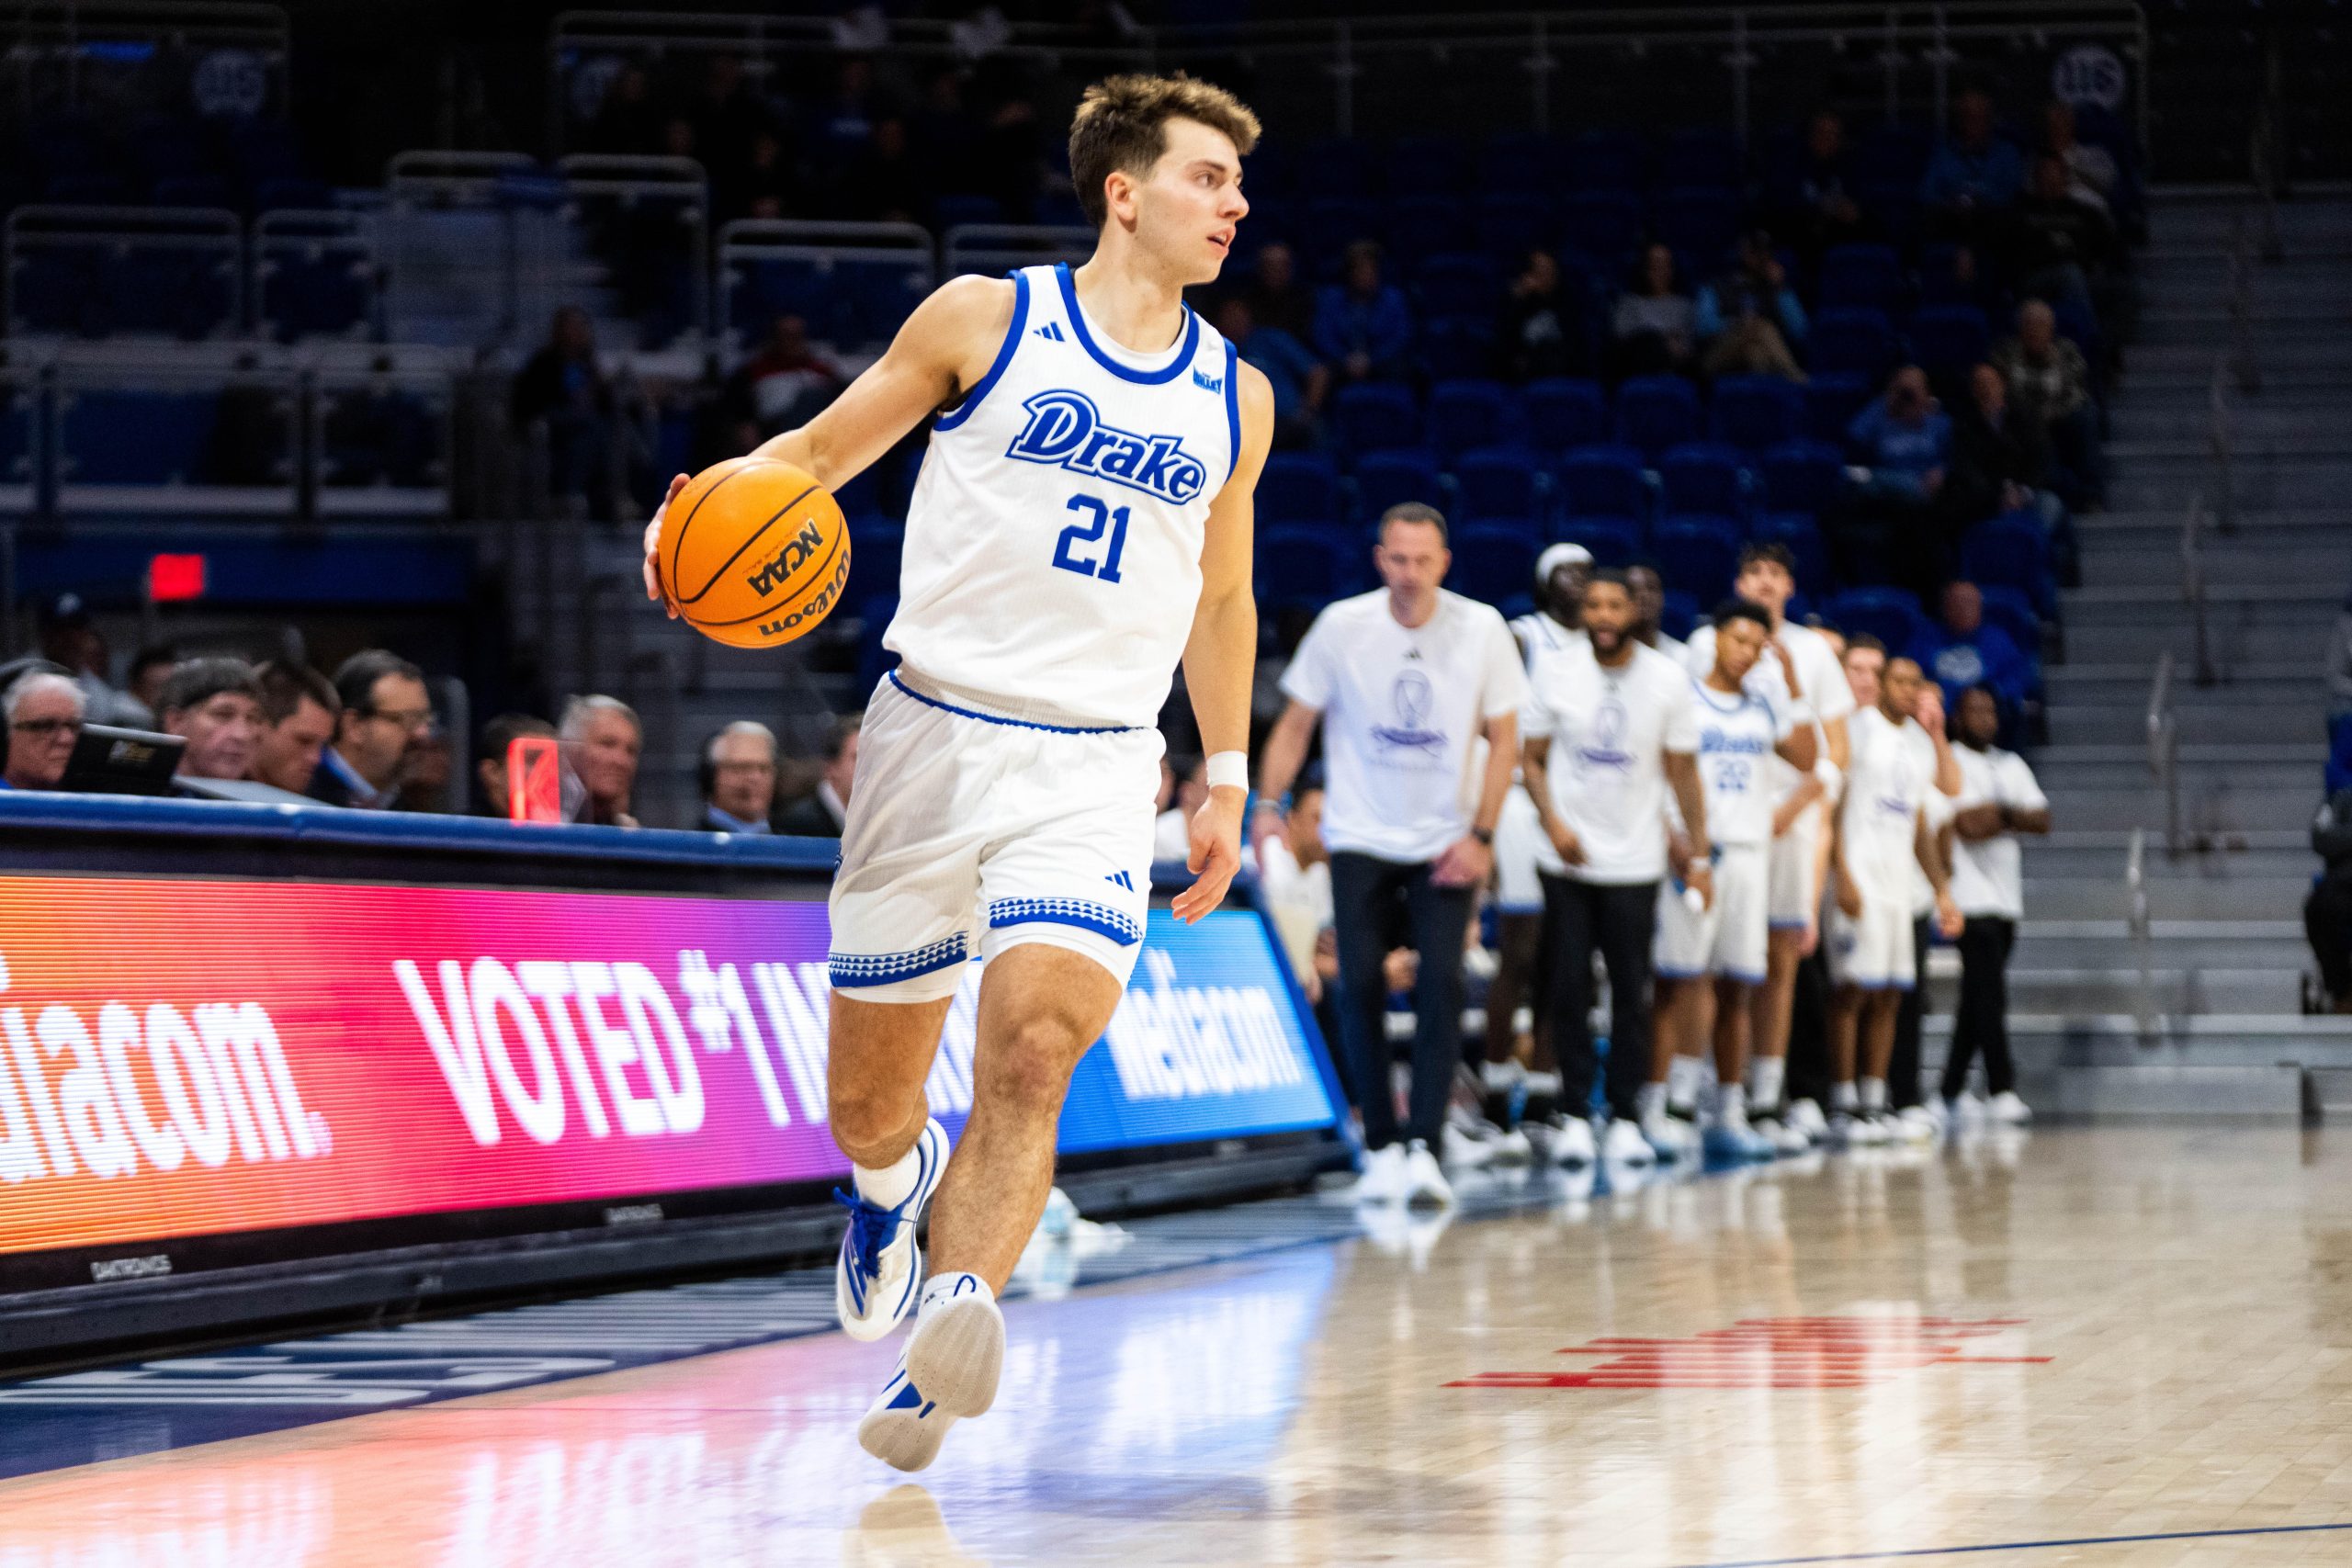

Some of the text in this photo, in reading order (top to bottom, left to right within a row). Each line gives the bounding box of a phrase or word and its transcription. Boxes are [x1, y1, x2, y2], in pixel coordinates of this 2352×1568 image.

[1005, 389, 1206, 505] Drake
[746, 518, 823, 597] NCAA
[1052, 493, 1131, 583] 21
[392, 956, 706, 1146] VOTED
